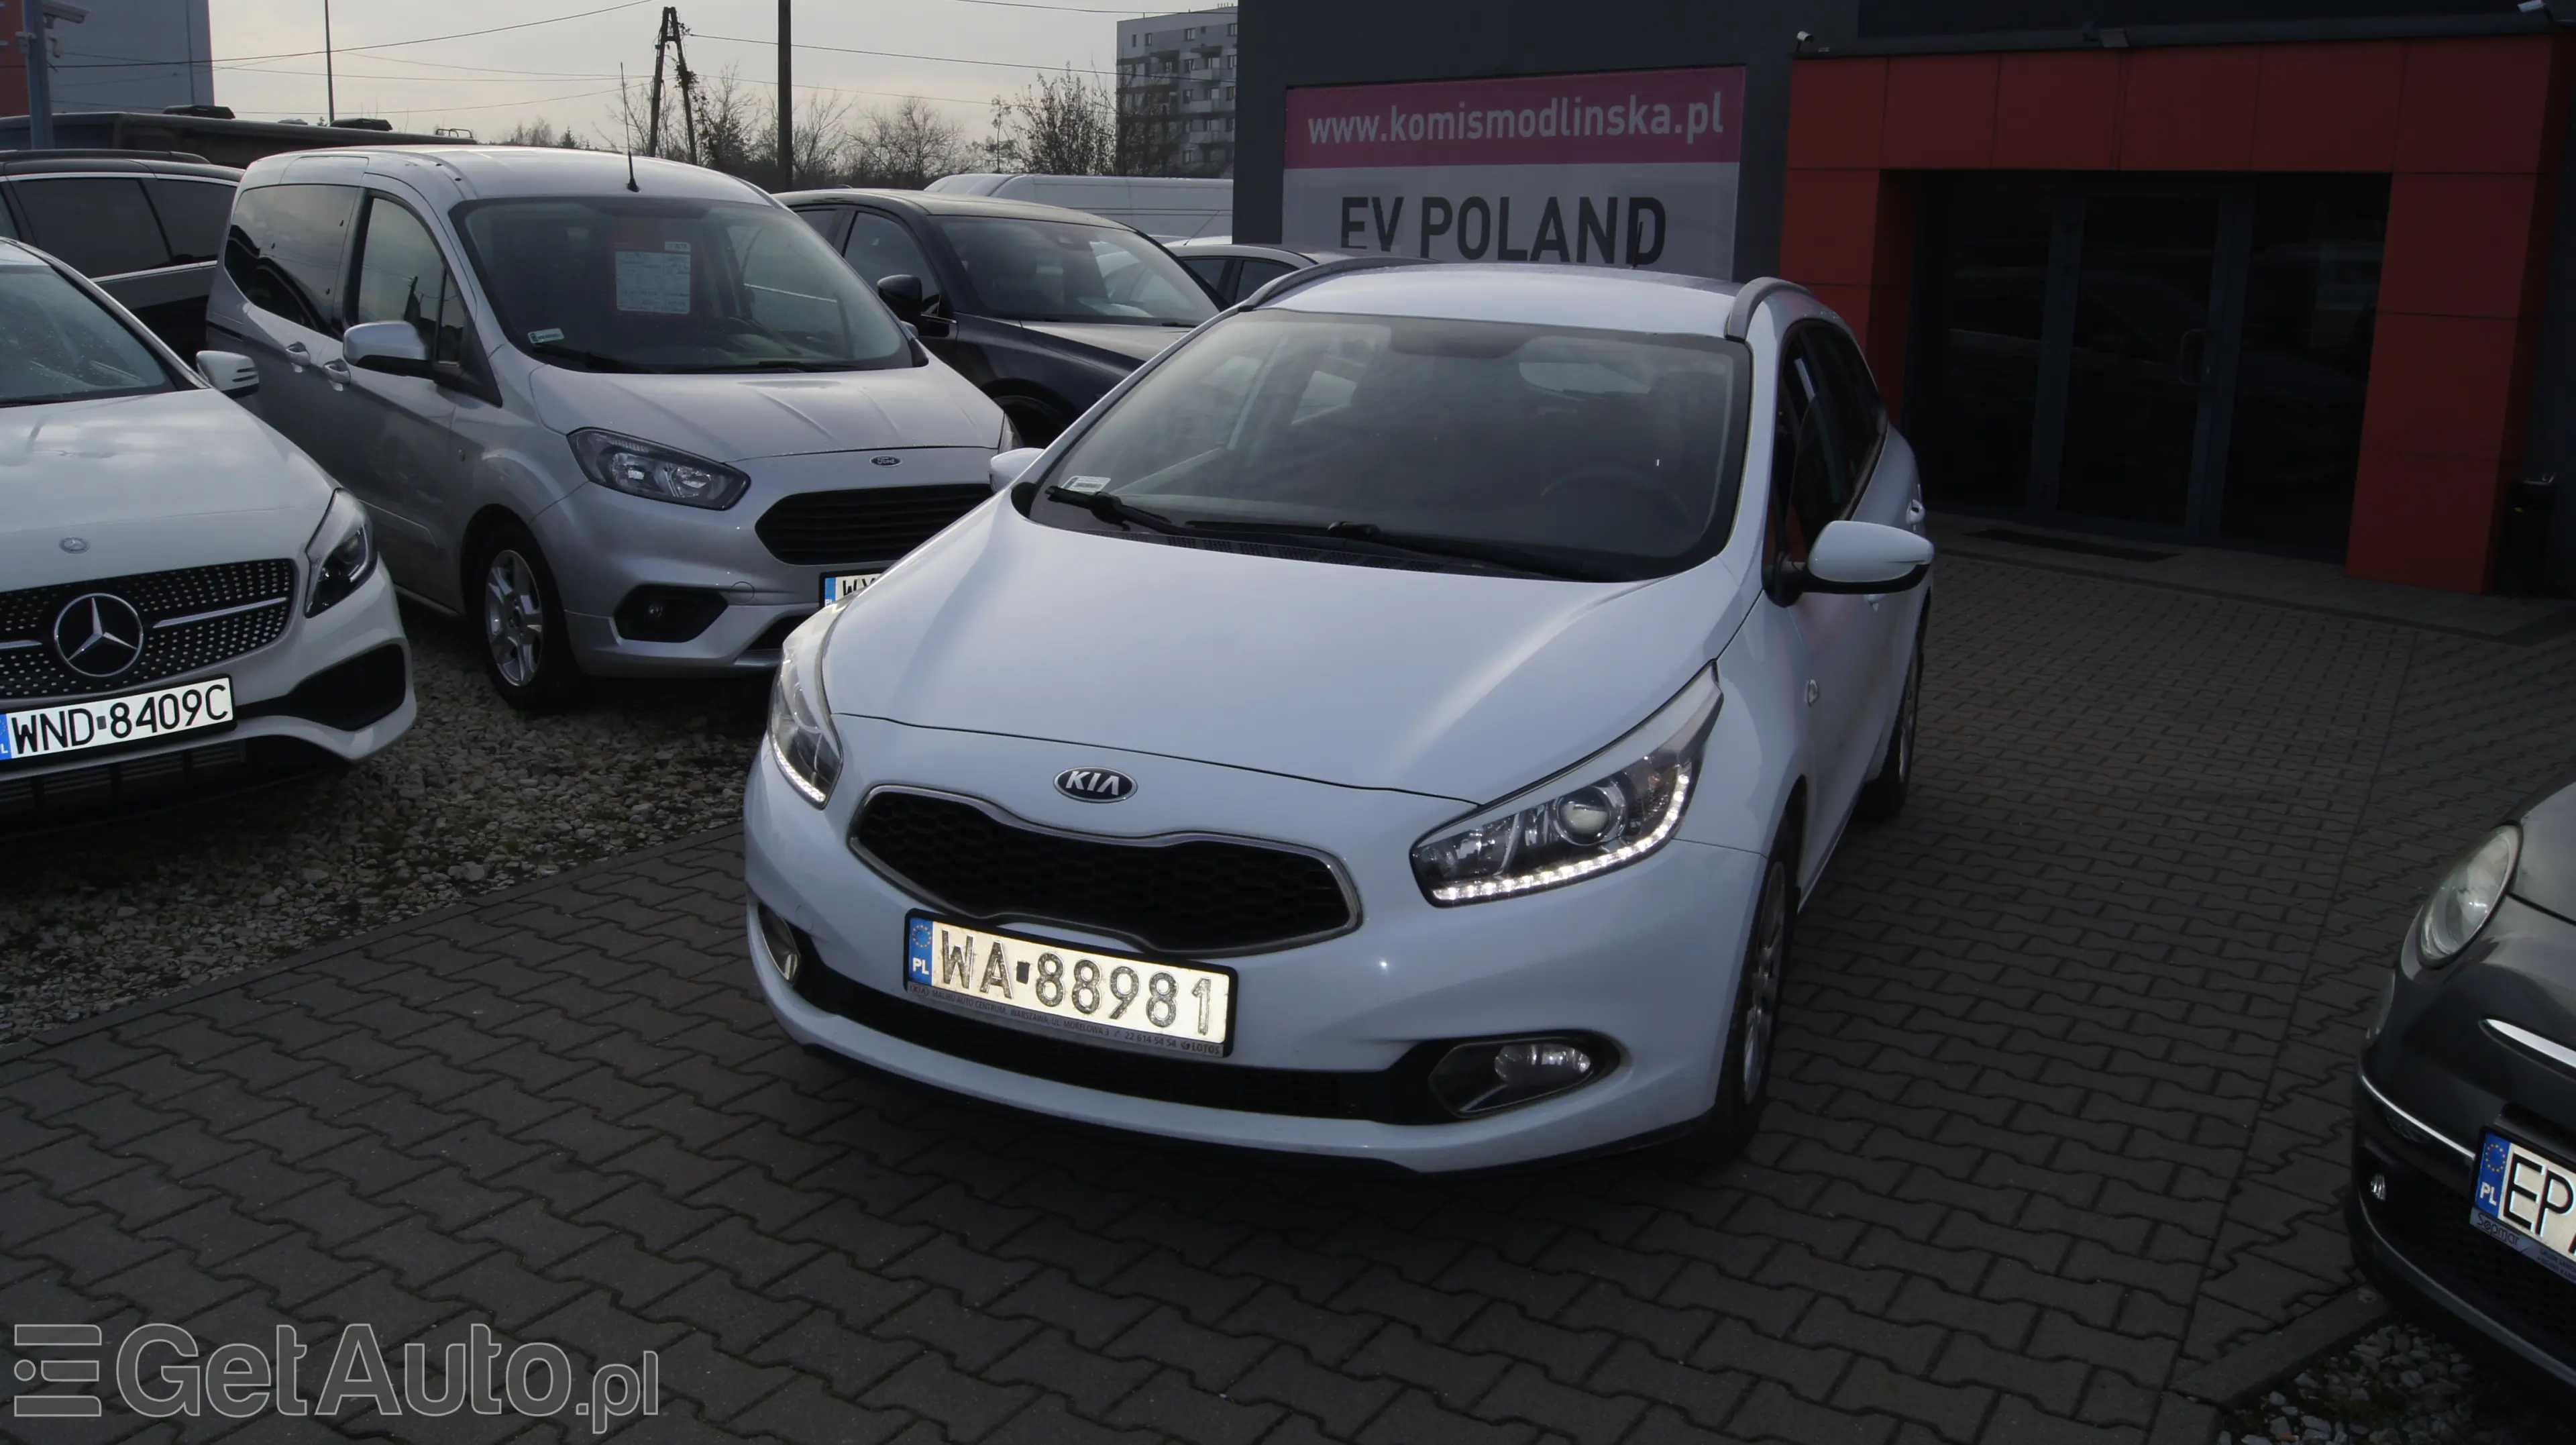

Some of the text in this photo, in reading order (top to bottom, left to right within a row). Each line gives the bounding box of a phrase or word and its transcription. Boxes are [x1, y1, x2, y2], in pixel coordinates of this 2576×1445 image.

[1308, 91, 1724, 144] www.komismodlinska.pl
[1340, 196, 1666, 266] EV POLAND
[877, 456, 896, 465] Ford
[11, 684, 229, 755] WND 8409C
[1065, 770, 1120, 796] KIA
[912, 957, 930, 975] PL
[941, 930, 1211, 1036] WA 88981
[932, 989, 956, 1002] MALIBU
[957, 997, 974, 1007] AUTO
[1063, 1020, 1104, 1035] MORELOWA
[1105, 1028, 1110, 1036] 3
[1124, 1031, 1134, 1041] 22
[1136, 1034, 1152, 1045] 614
[1154, 1037, 1164, 1046] 54
[1167, 1038, 1177, 1048] 54
[1191, 1043, 1220, 1055] LOTOS
[2479, 1181, 2498, 1206] PL
